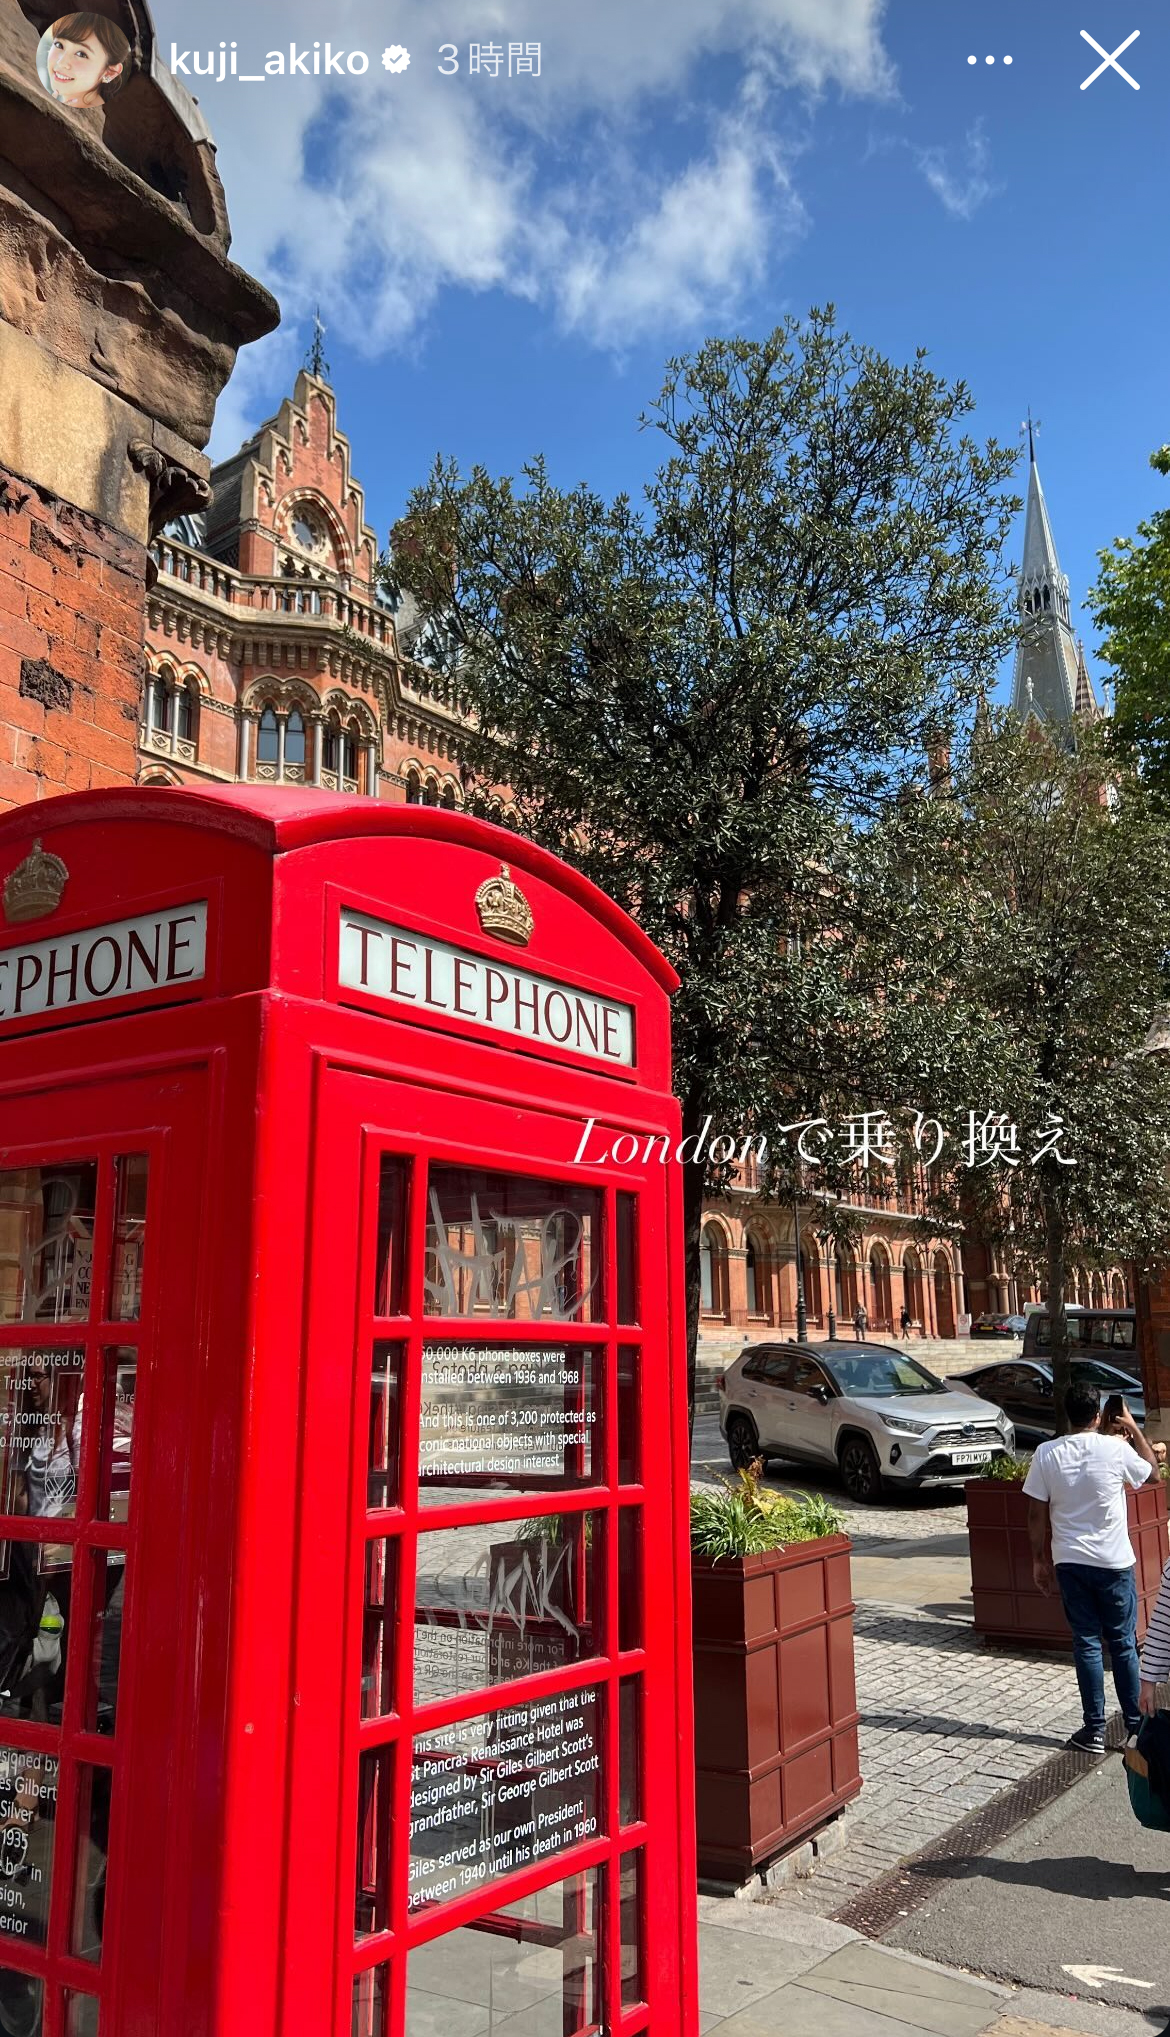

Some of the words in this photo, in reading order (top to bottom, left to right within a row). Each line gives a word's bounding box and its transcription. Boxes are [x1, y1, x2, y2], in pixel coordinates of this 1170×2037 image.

[346, 922, 622, 1058] TELEPHONE
[21, 1351, 70, 1370] adopted
[72, 1351, 86, 1370] by
[461, 1347, 476, 1361] K6
[478, 1347, 510, 1364] phone
[512, 1347, 541, 1362] boxes
[543, 1352, 566, 1363] were
[4, 1375, 33, 1390] Trust
[467, 1369, 512, 1384] between
[513, 1370, 536, 1384] 1936
[538, 1370, 556, 1384] and
[557, 1370, 579, 1384] 1968
[15, 1410, 62, 1425] connect
[419, 1413, 439, 1428] And
[442, 1411, 463, 1427] this
[465, 1411, 474, 1426] is
[476, 1414, 496, 1426] one
[498, 1410, 509, 1426] of
[510, 1410, 538, 1427] 3,200
[540, 1408, 585, 1427] protected
[586, 1411, 596, 1423] as
[10, 1432, 55, 1452] improve
[452, 1433, 494, 1450] national
[496, 1433, 533, 1451] objects
[535, 1430, 556, 1446] with
[558, 1429, 589, 1448] special
[487, 1455, 520, 1473] design
[523, 1453, 560, 1469] interest
[435, 1732, 456, 1749] site
[459, 1727, 467, 1741] is
[470, 1720, 493, 1739] very
[496, 1710, 528, 1730] fitting
[530, 1702, 557, 1724] given
[559, 1693, 578, 1711] that
[580, 1689, 596, 1706] the
[423, 1753, 468, 1778] Pancras
[470, 1732, 534, 1763] Renaissance
[536, 1719, 563, 1742] Hotel
[565, 1716, 584, 1733] was
[0, 1748, 41, 1776] signed
[45, 1754, 59, 1777] by
[410, 1775, 460, 1809] designed
[463, 1773, 478, 1791] by
[480, 1766, 494, 1785] Sir
[496, 1759, 523, 1779] Giles
[525, 1745, 559, 1769] Gilbert
[561, 1733, 593, 1757] Scott's
[14, 1776, 58, 1801] Gilbert
[408, 1800, 479, 1840] grandfather,
[481, 1790, 496, 1809] Sir
[498, 1779, 537, 1803] George
[538, 1763, 573, 1788] Gilbert
[574, 1754, 599, 1777] Scott
[0, 1800, 34, 1822] Silver
[1, 1828, 28, 1850] 1935
[408, 1859, 435, 1881] Giles
[438, 1838, 477, 1869] served
[478, 1837, 491, 1852] as
[493, 1829, 513, 1847] our
[513, 1820, 536, 1839] own
[538, 1799, 584, 1829] President
[460, 1861, 486, 1886] 1940
[489, 1849, 513, 1874] until
[515, 1844, 530, 1863] his
[532, 1831, 561, 1856] death
[563, 1828, 573, 1843] in
[573, 1817, 597, 1838] 1960
[31, 1863, 42, 1883] in
